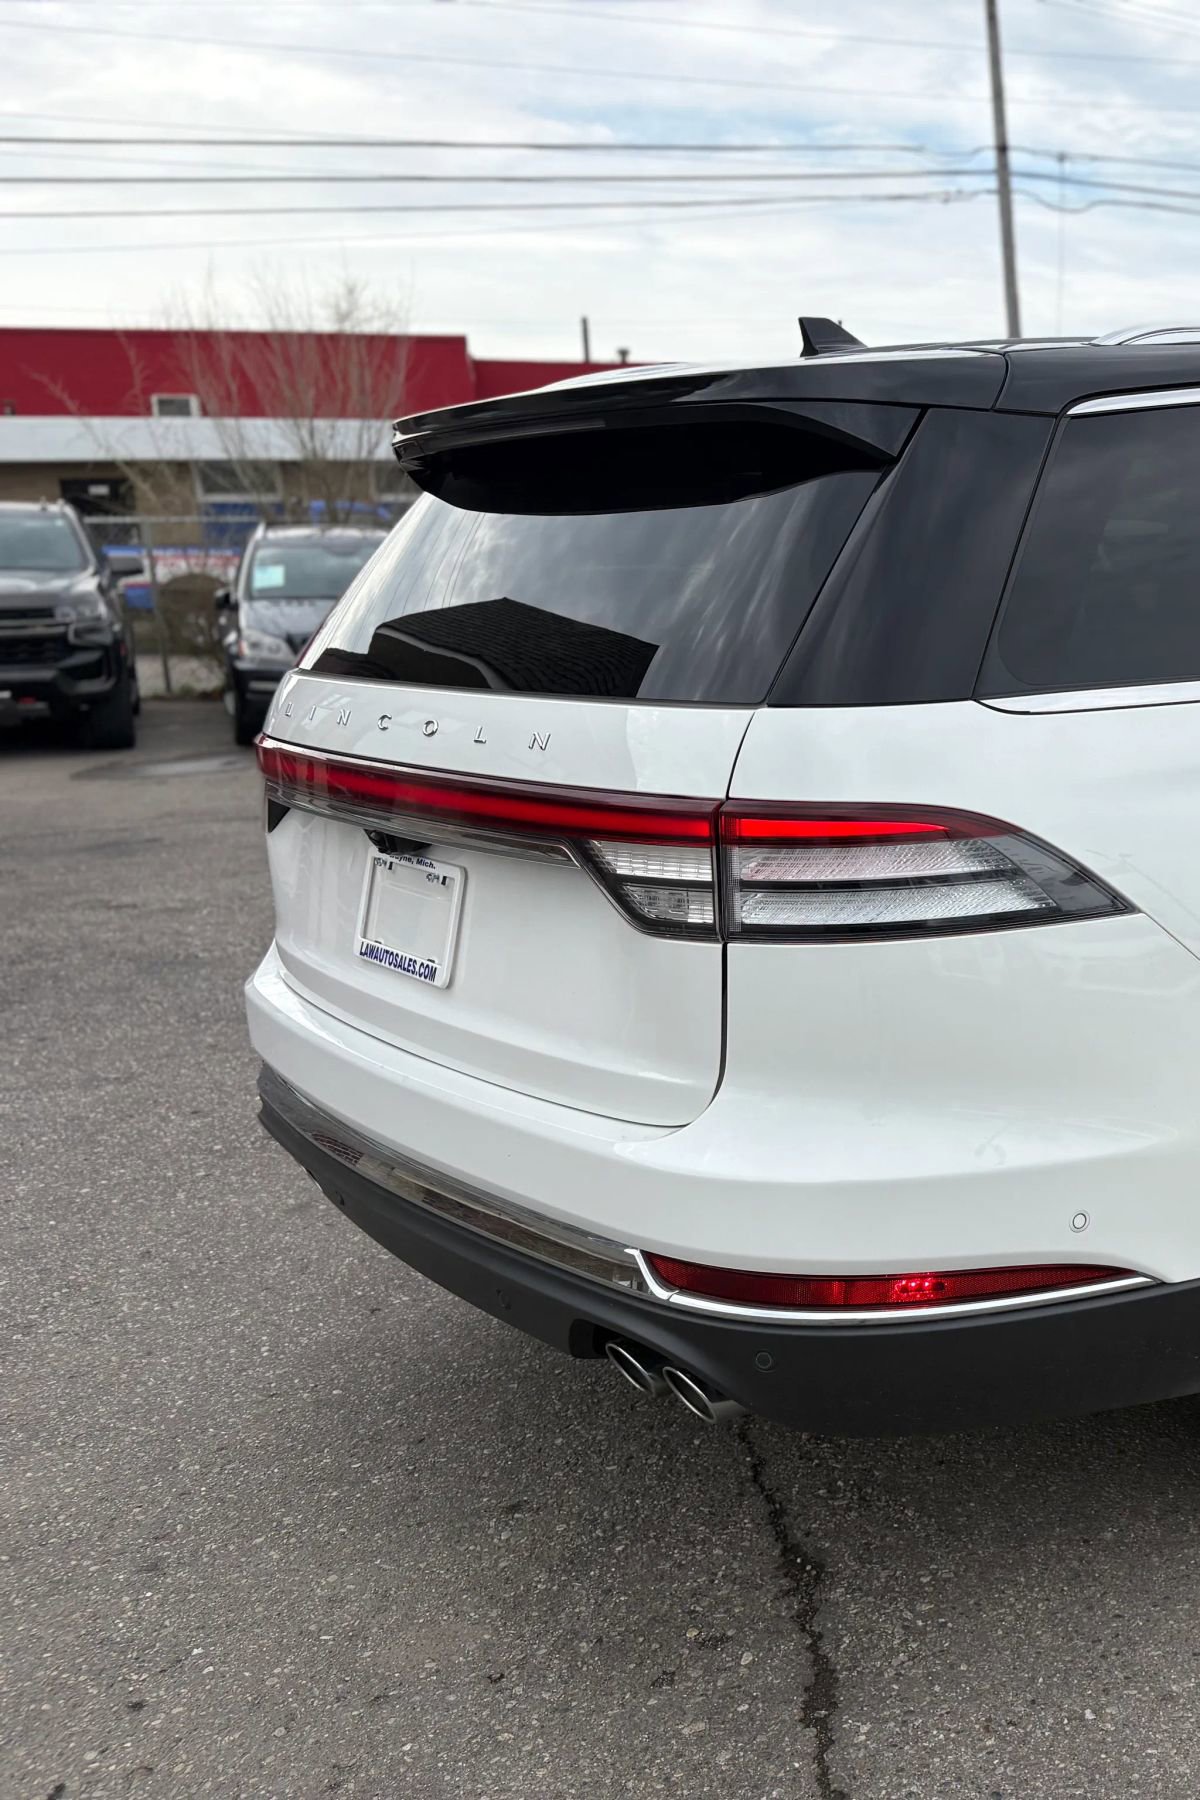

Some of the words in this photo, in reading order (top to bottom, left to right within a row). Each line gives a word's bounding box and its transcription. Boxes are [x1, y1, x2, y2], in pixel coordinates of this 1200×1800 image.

[284, 701, 551, 751] LINCOLN
[416, 858, 436, 870] Mich.
[359, 941, 438, 983] LAWAUTOSALES.COM
